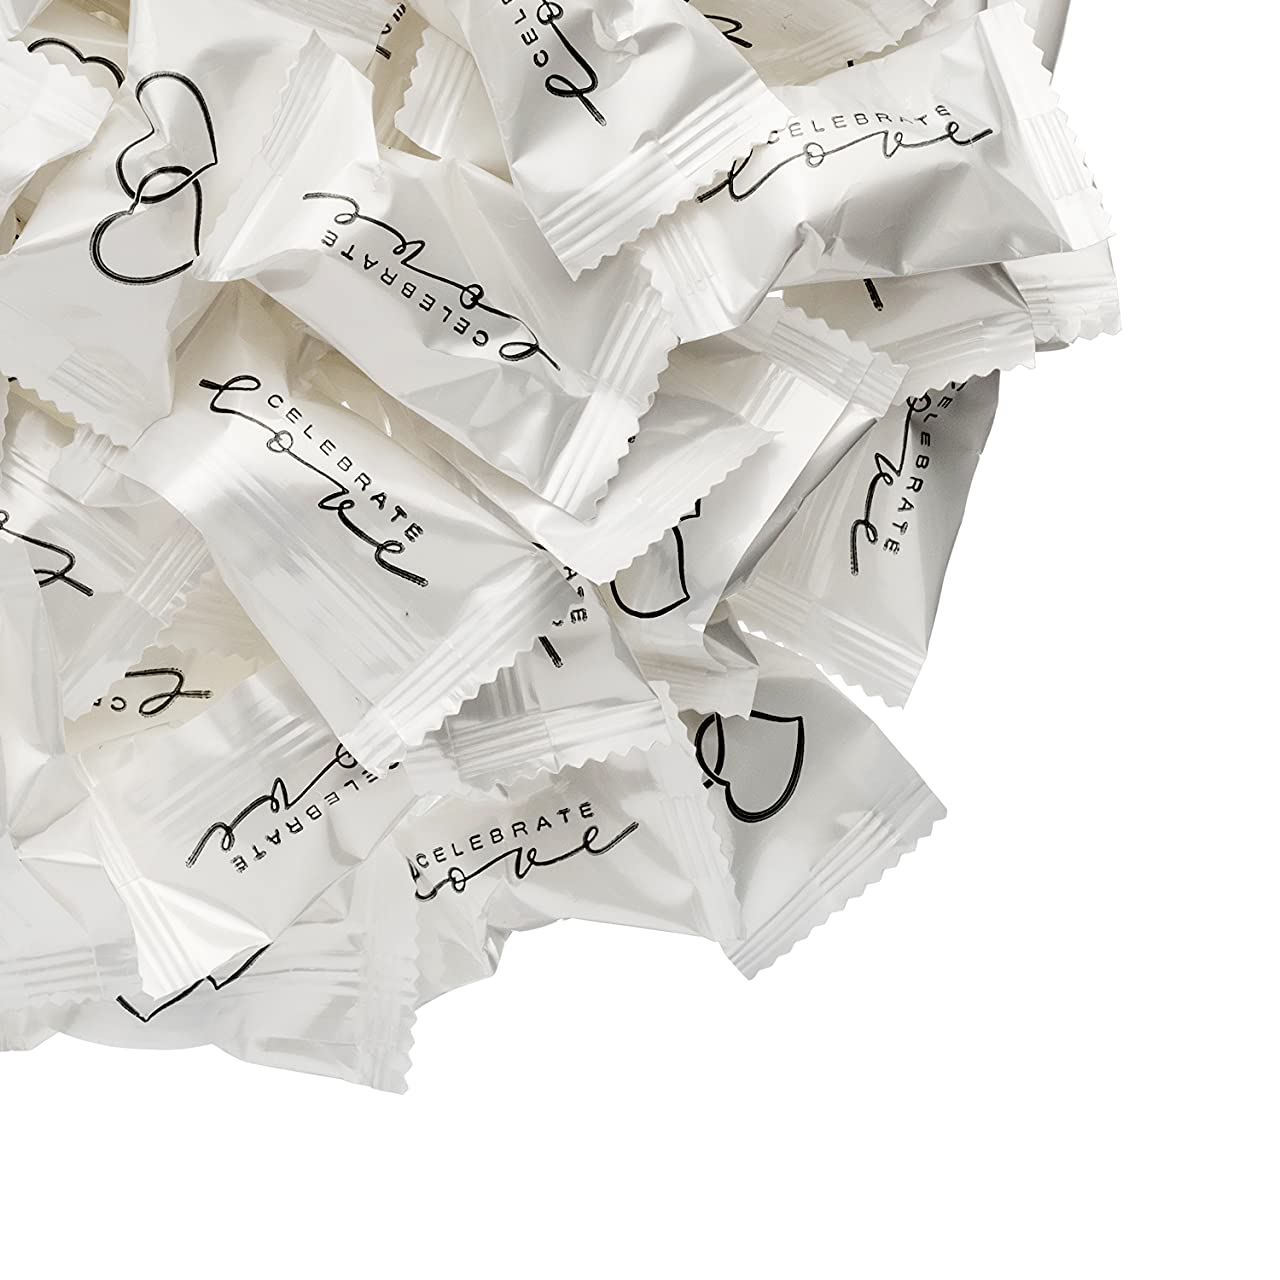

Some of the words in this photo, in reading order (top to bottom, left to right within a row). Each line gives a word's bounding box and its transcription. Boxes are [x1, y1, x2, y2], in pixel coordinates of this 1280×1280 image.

[302, 192, 561, 372] love
[320, 229, 489, 347] CELEBRATE
[199, 374, 428, 588] love
[267, 395, 424, 543] CELEBRATE
[850, 394, 932, 576] ove
[186, 743, 357, 867] ove
[231, 766, 390, 872] ELEBRATE
[416, 802, 594, 869] CELEBRATE
